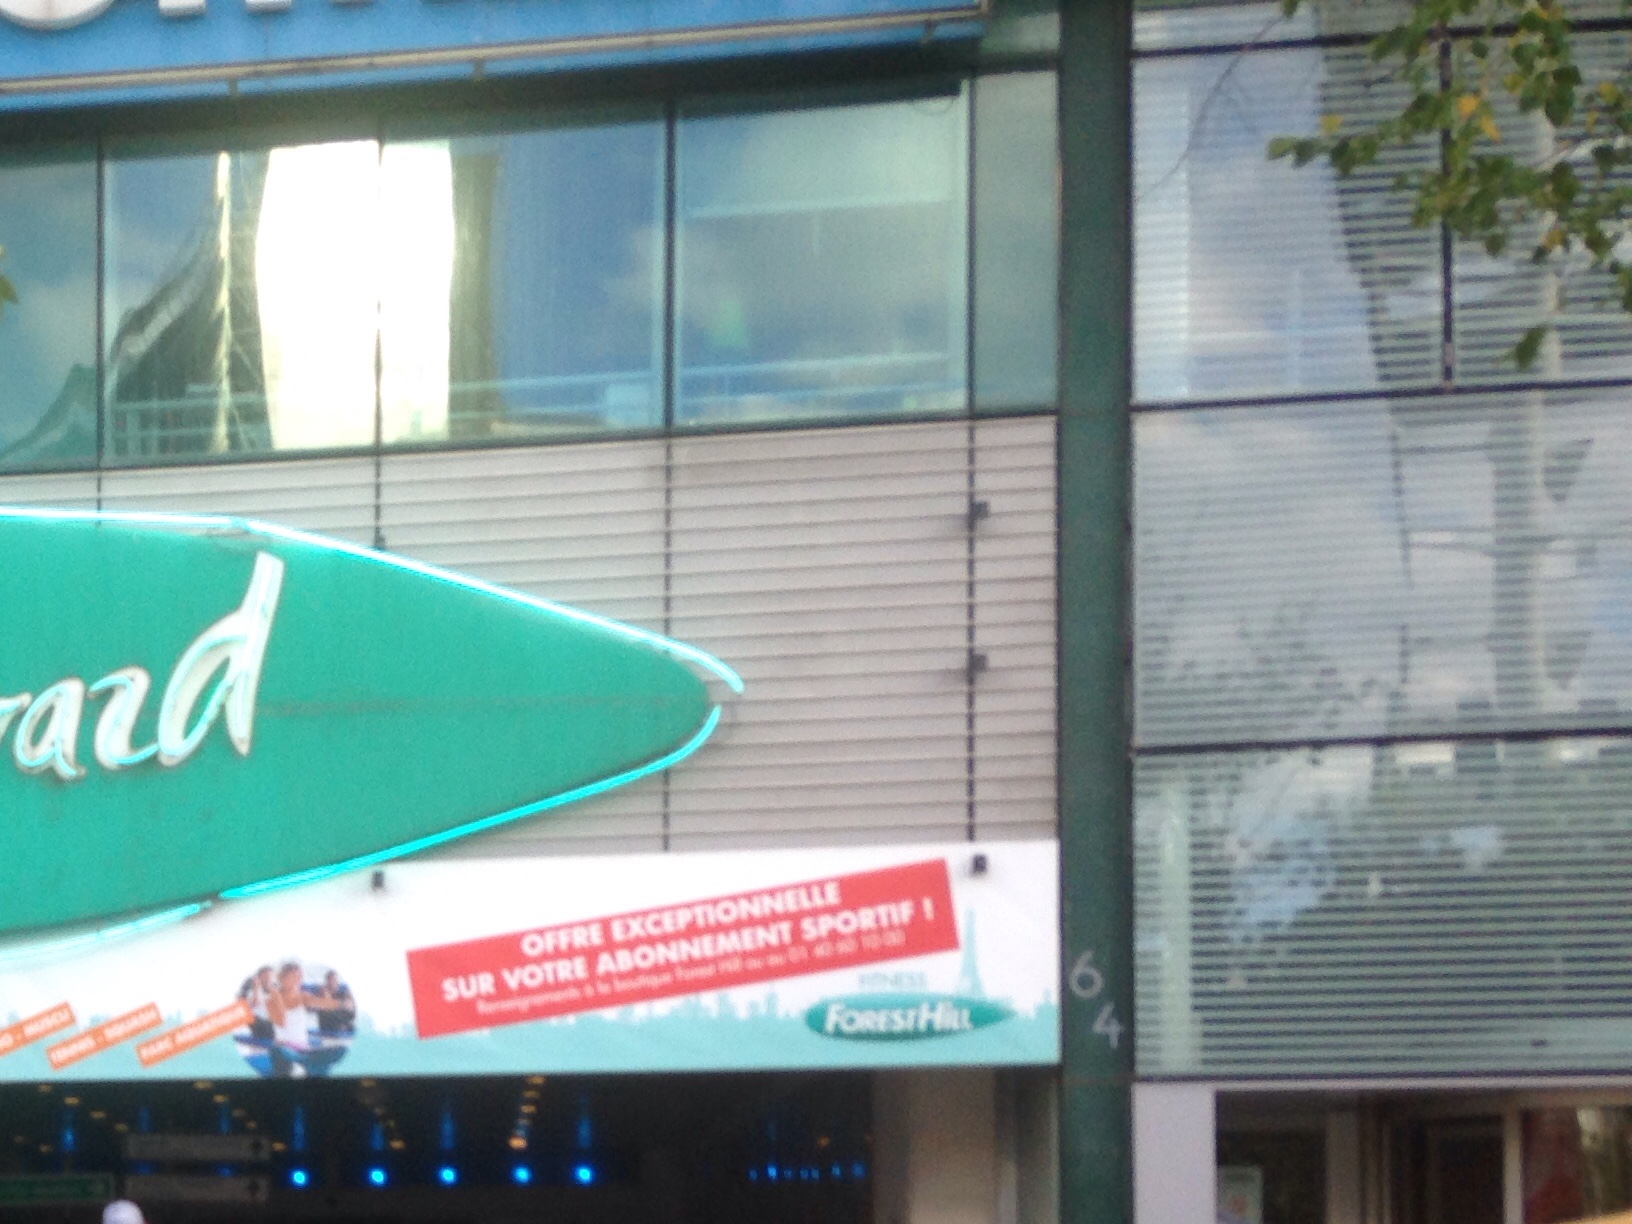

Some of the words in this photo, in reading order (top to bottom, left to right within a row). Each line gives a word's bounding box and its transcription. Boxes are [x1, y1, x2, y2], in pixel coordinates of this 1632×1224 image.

[441, 970, 496, 1002] SUR
[502, 955, 589, 990] VOTRE
[596, 920, 793, 974] ABONNEMENT
[800, 899, 915, 941] SPORTIF
[521, 924, 604, 957] OFFRE
[611, 880, 841, 941] EXCEPTIONNELLE
